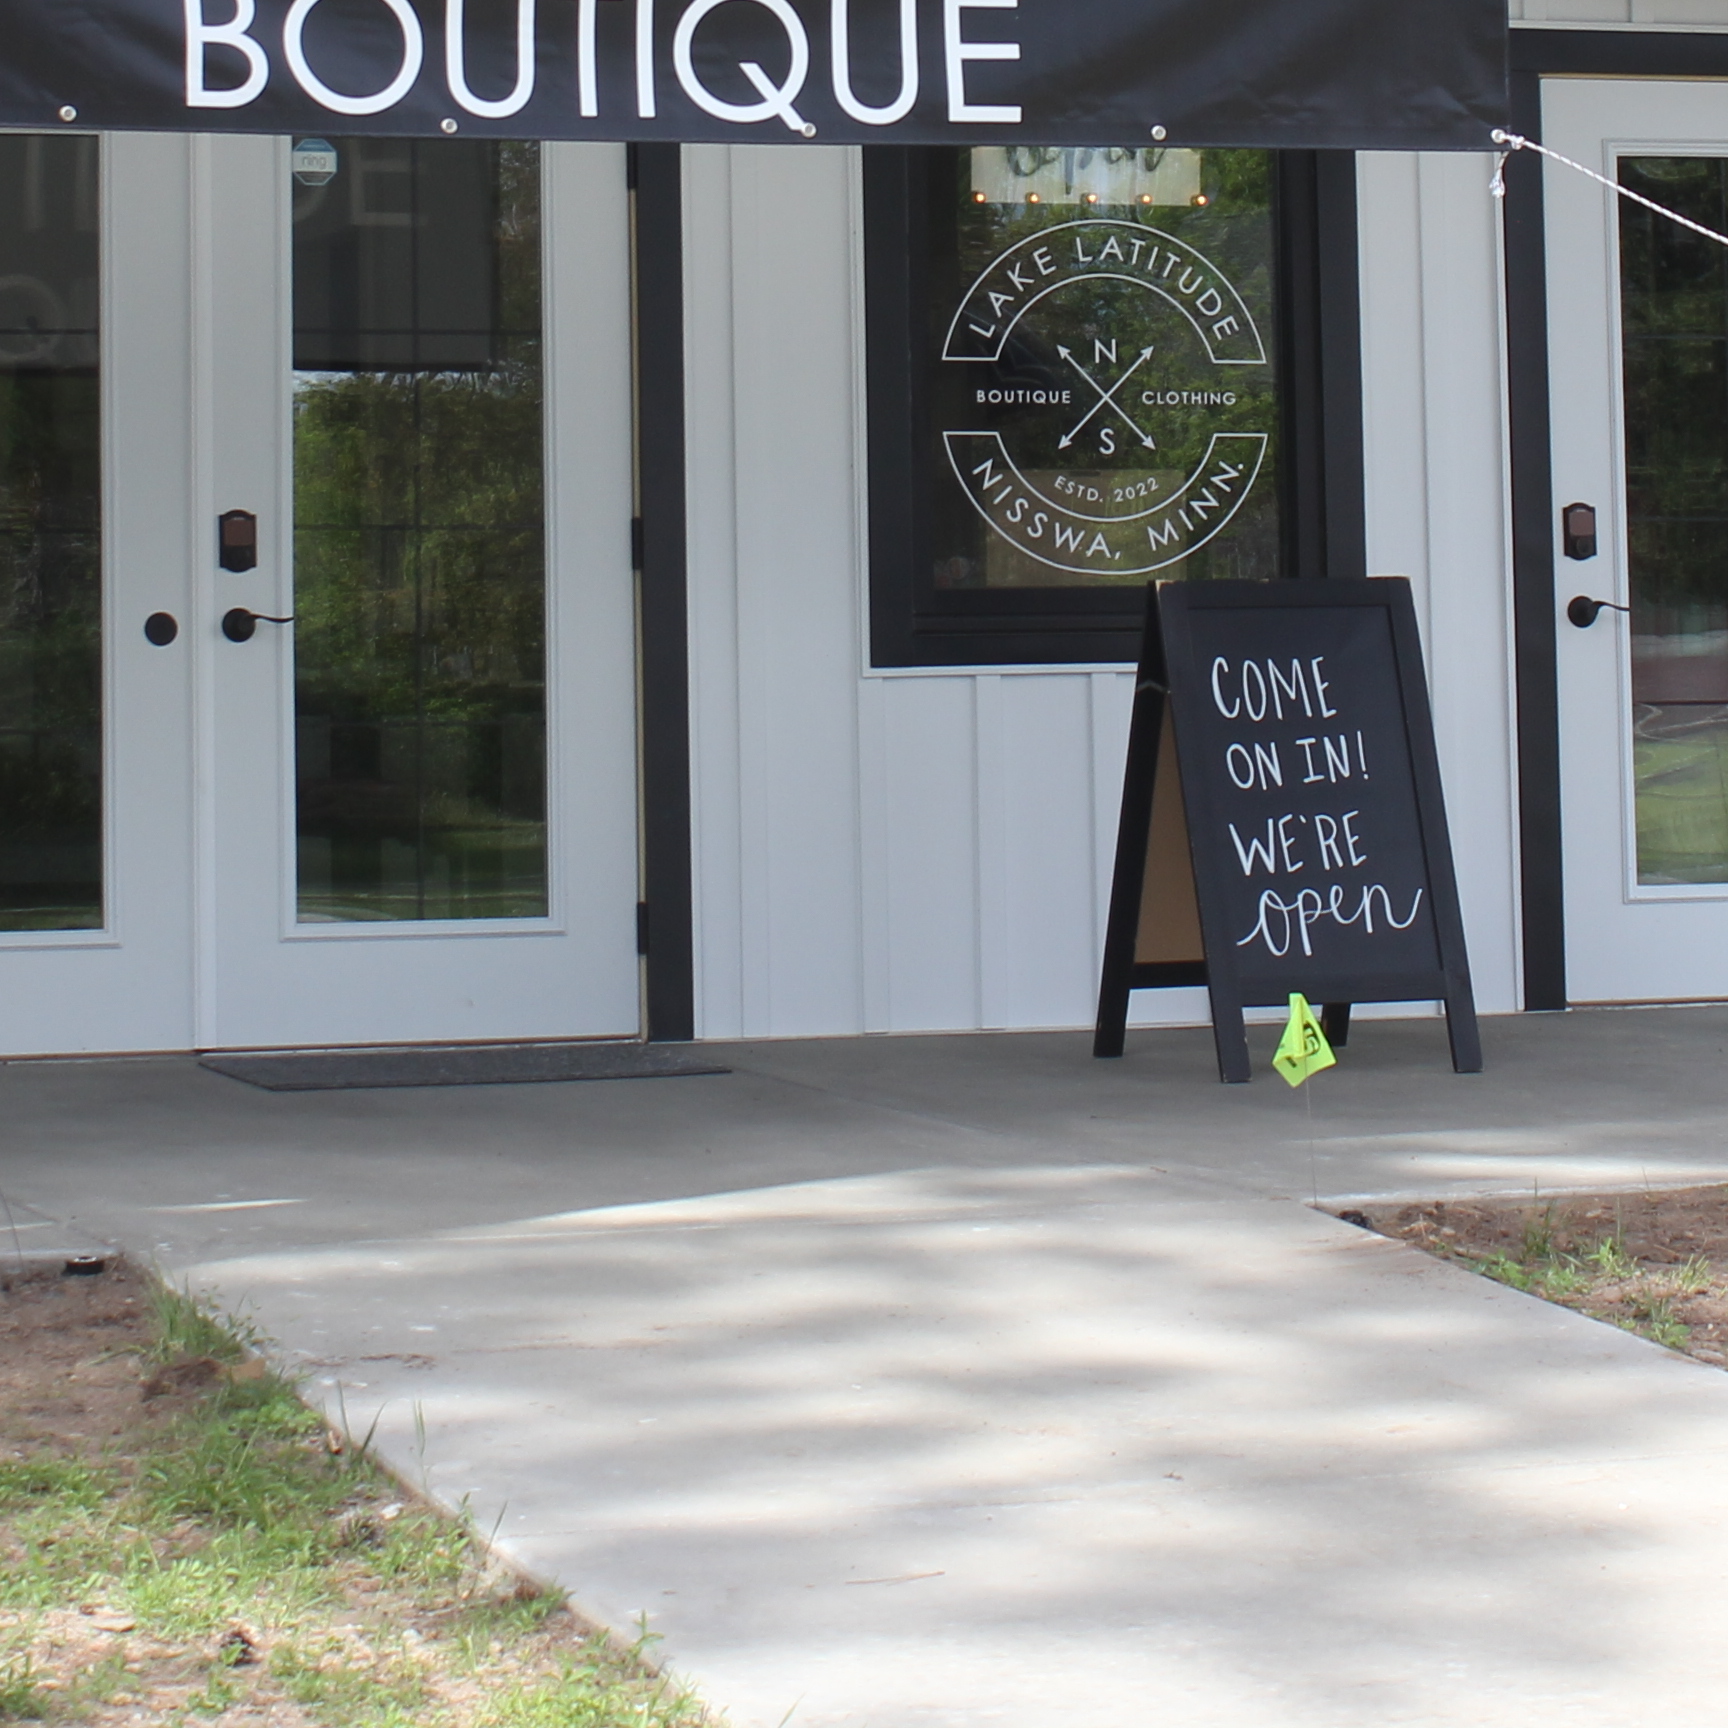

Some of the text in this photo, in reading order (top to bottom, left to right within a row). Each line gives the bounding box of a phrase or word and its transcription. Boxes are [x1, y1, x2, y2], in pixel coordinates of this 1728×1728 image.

[969, 236, 1240, 341] LAKE LATITUDE
[1094, 338, 1117, 364] N
[975, 388, 1238, 406] BOUTIQUE CLOTHING
[1099, 428, 1116, 456] S
[972, 458, 1245, 561] NISSWA, MINN.
[1054, 475, 1160, 503] ESTD. 2022
[1211, 656, 1338, 723] COME
[1226, 730, 1370, 791] ON IN!
[1228, 810, 1368, 877] WE'RE
[1236, 884, 1424, 957] open
